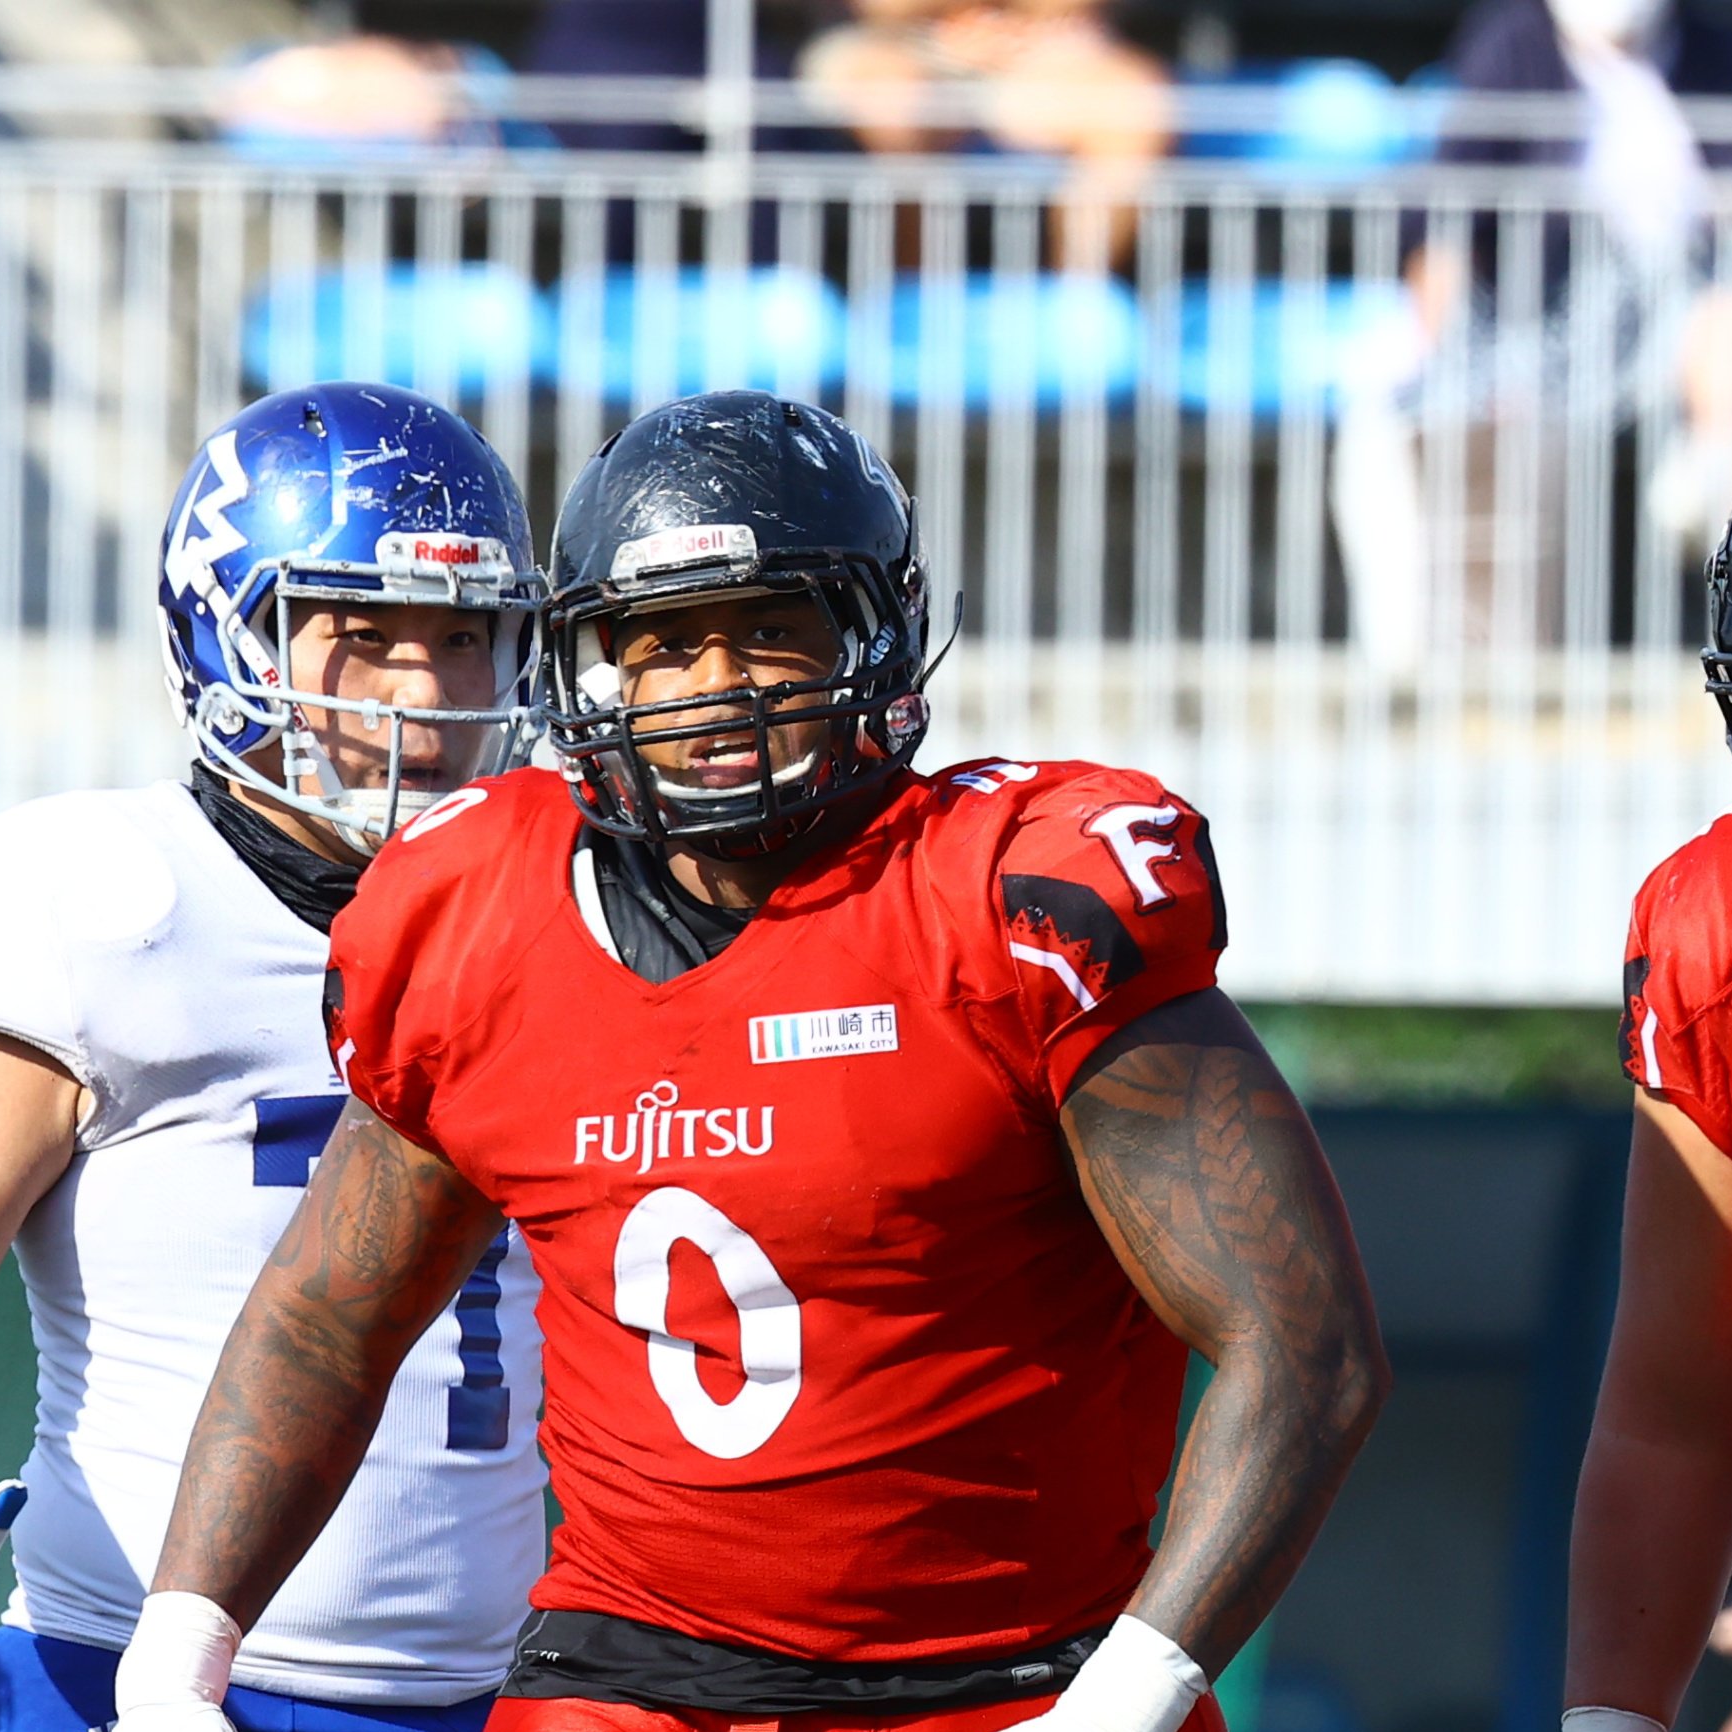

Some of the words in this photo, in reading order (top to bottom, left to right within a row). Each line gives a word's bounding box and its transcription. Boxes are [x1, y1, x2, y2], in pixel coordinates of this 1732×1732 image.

[415, 541, 479, 564] Riddell
[649, 530, 724, 558] Rddell
[1084, 803, 1182, 912] F
[811, 1010, 893, 1039] 川崎市
[812, 1041, 865, 1053] KAWASAKI
[870, 1039, 894, 1049] CITY
[574, 1082, 774, 1175] FUJITSU
[614, 1186, 802, 1460] 0
